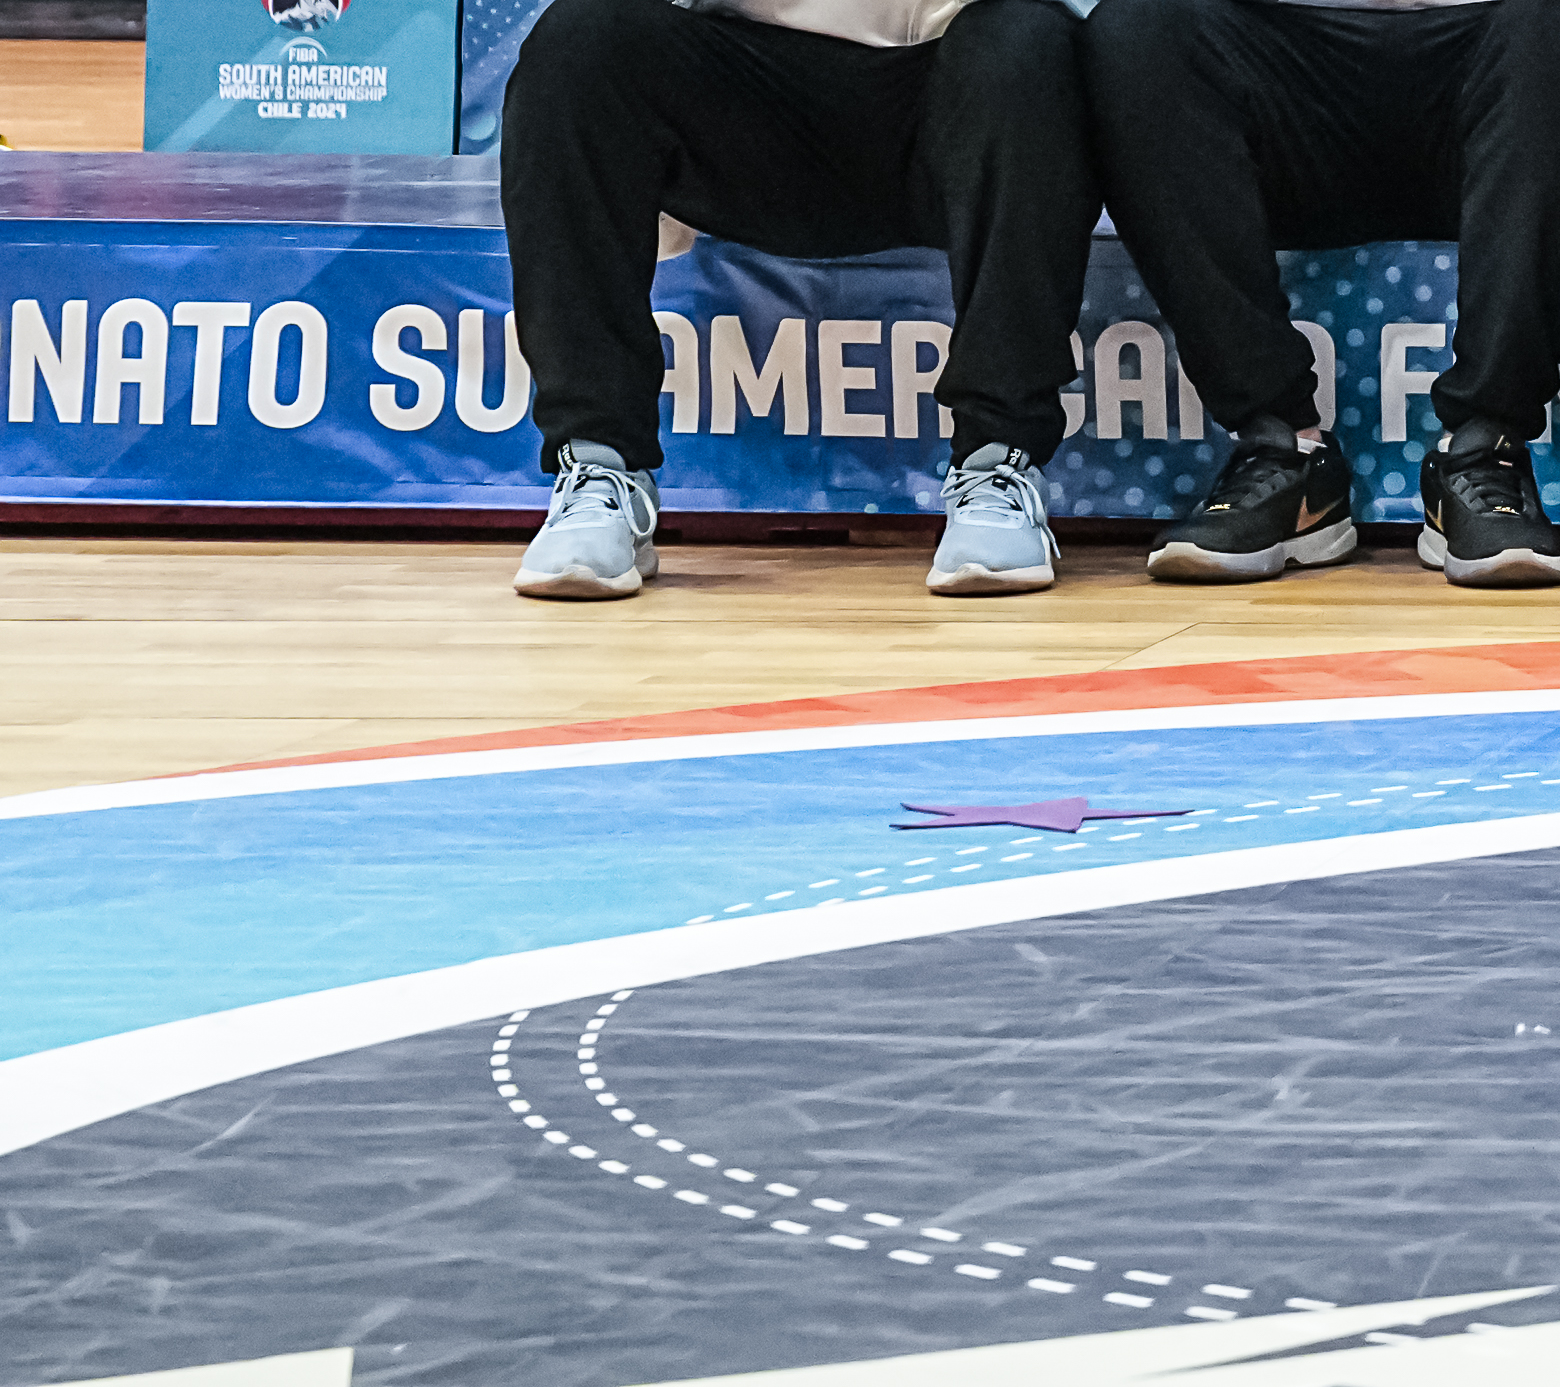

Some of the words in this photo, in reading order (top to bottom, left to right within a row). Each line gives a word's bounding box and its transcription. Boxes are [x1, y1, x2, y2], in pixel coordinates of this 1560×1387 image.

[289, 48, 318, 62] FIBA
[219, 64, 283, 85] SOUTH
[287, 64, 388, 86] AMERICAN
[219, 84, 284, 101] WOMEN'S
[287, 84, 388, 101] CHAMPIONSHIP
[258, 102, 301, 119] CHILE
[306, 102, 347, 119] 2024
[8, 297, 328, 427] NATO
